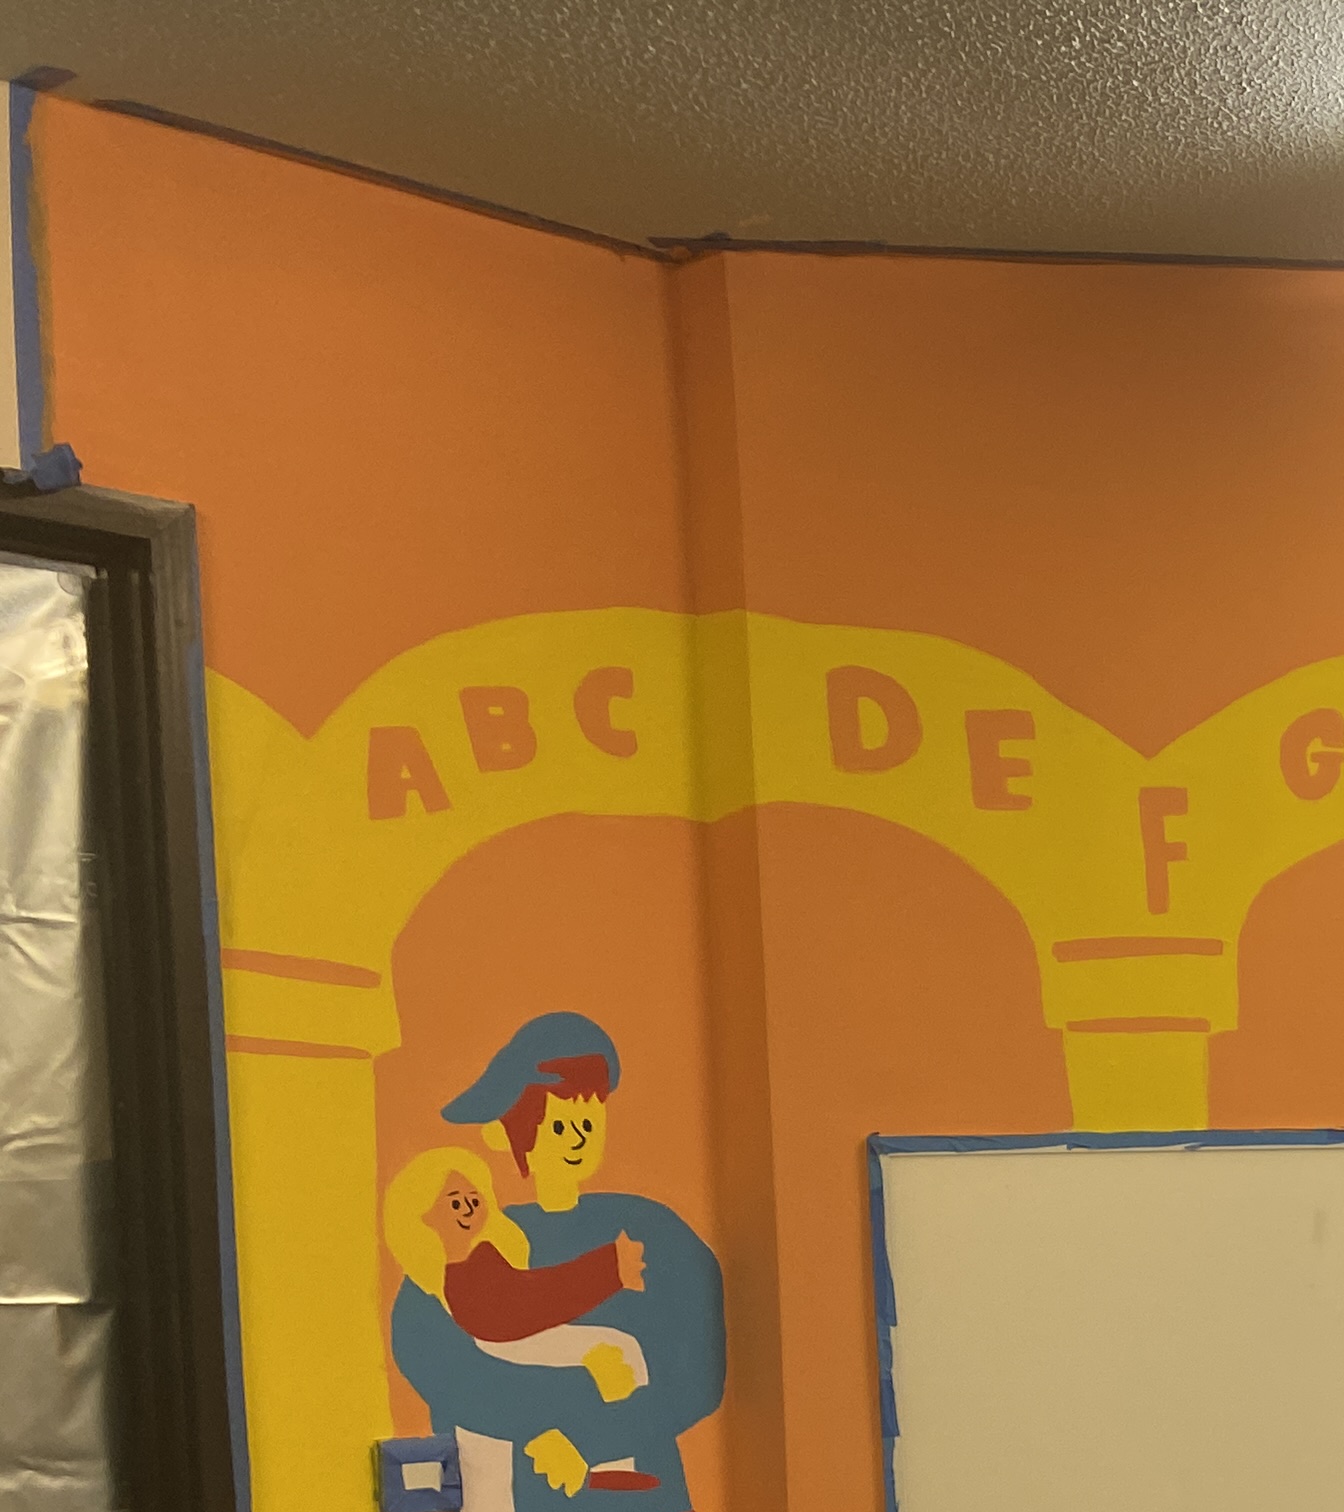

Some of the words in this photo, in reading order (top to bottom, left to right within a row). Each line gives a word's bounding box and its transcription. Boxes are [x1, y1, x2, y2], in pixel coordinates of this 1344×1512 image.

[367, 726, 451, 820] A
[458, 686, 537, 773] B
[573, 666, 638, 758] C
[825, 665, 923, 774] D
[965, 709, 1035, 810] E
[1138, 787, 1188, 914] F
